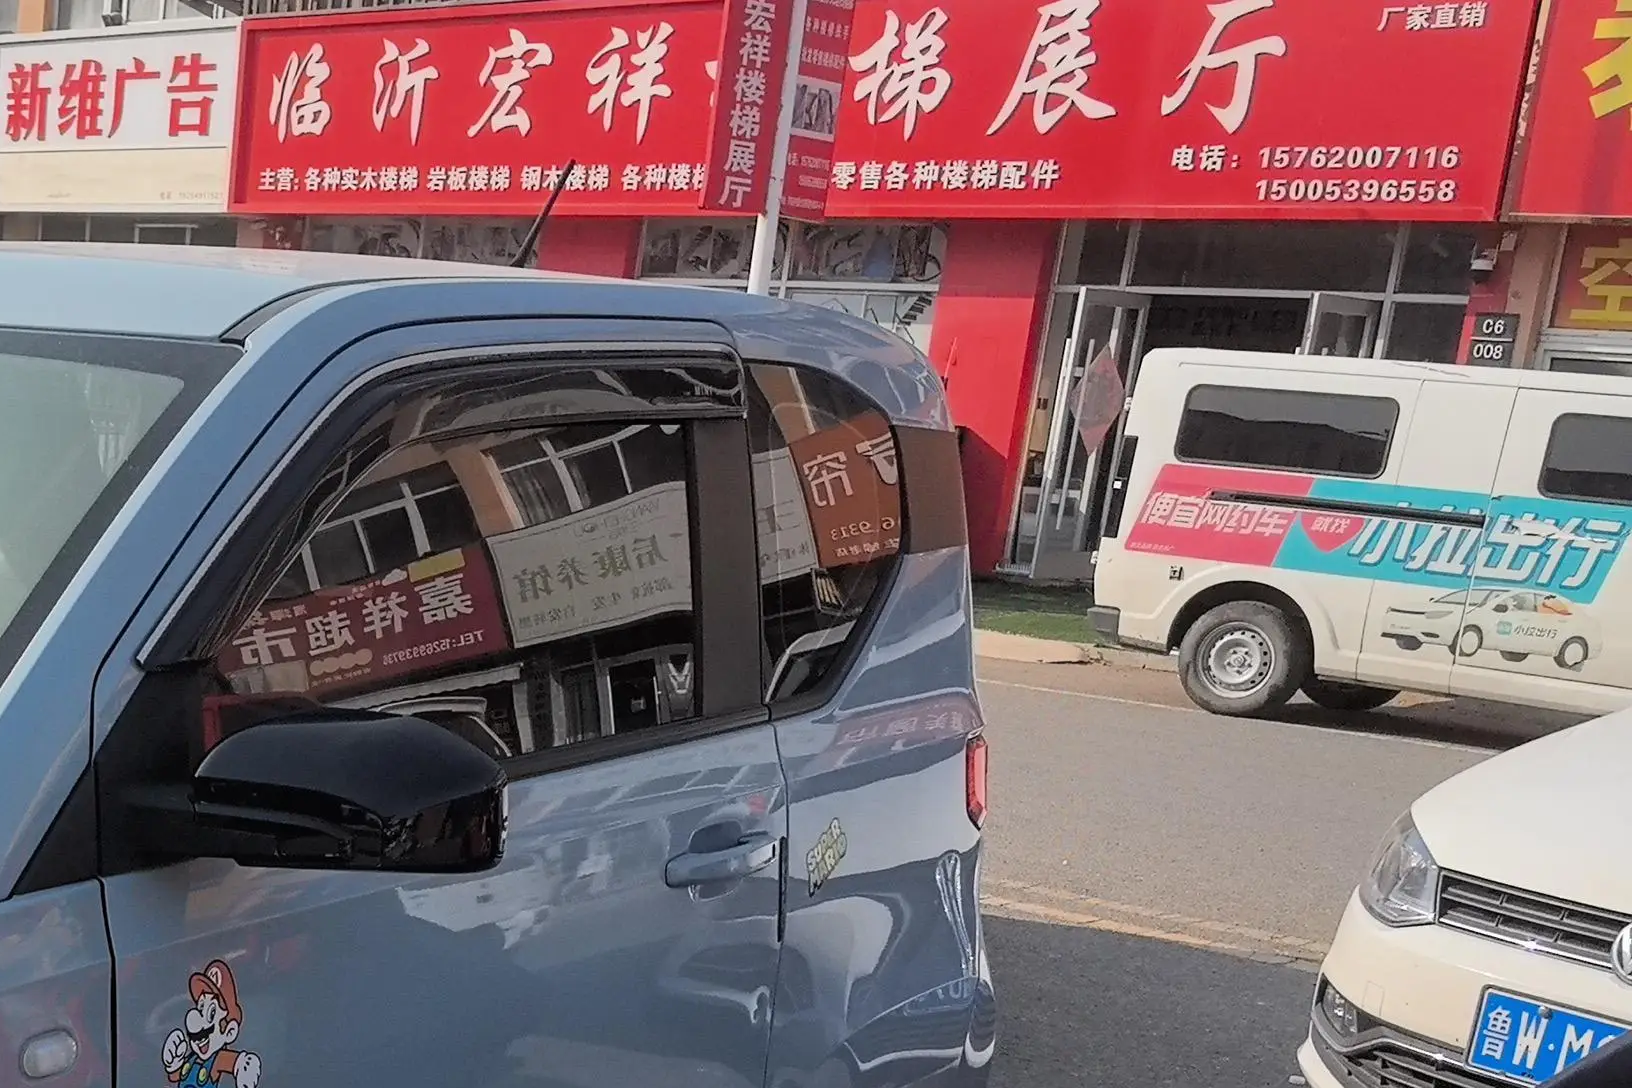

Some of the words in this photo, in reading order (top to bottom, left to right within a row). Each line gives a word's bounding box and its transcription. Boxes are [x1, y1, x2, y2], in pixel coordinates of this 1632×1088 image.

[1377, 2, 1487, 31] 厂家直销
[5, 53, 219, 141] 新维广告
[718, 0, 776, 208] 宏祥楼梯展厅
[427, 165, 511, 192] 岩板楼梯
[520, 165, 610, 191] 钢木楼梯
[831, 159, 1061, 191] 零售各种楼梯配件
[1254, 179, 1457, 203] 15005396558
[1482, 318, 1505, 334] C6
[1472, 343, 1503, 360] 008
[1311, 515, 1351, 534] 就找
[1347, 501, 1622, 589] 小拉出行
[1481, 1005, 1620, 1074] 鲁W·M
